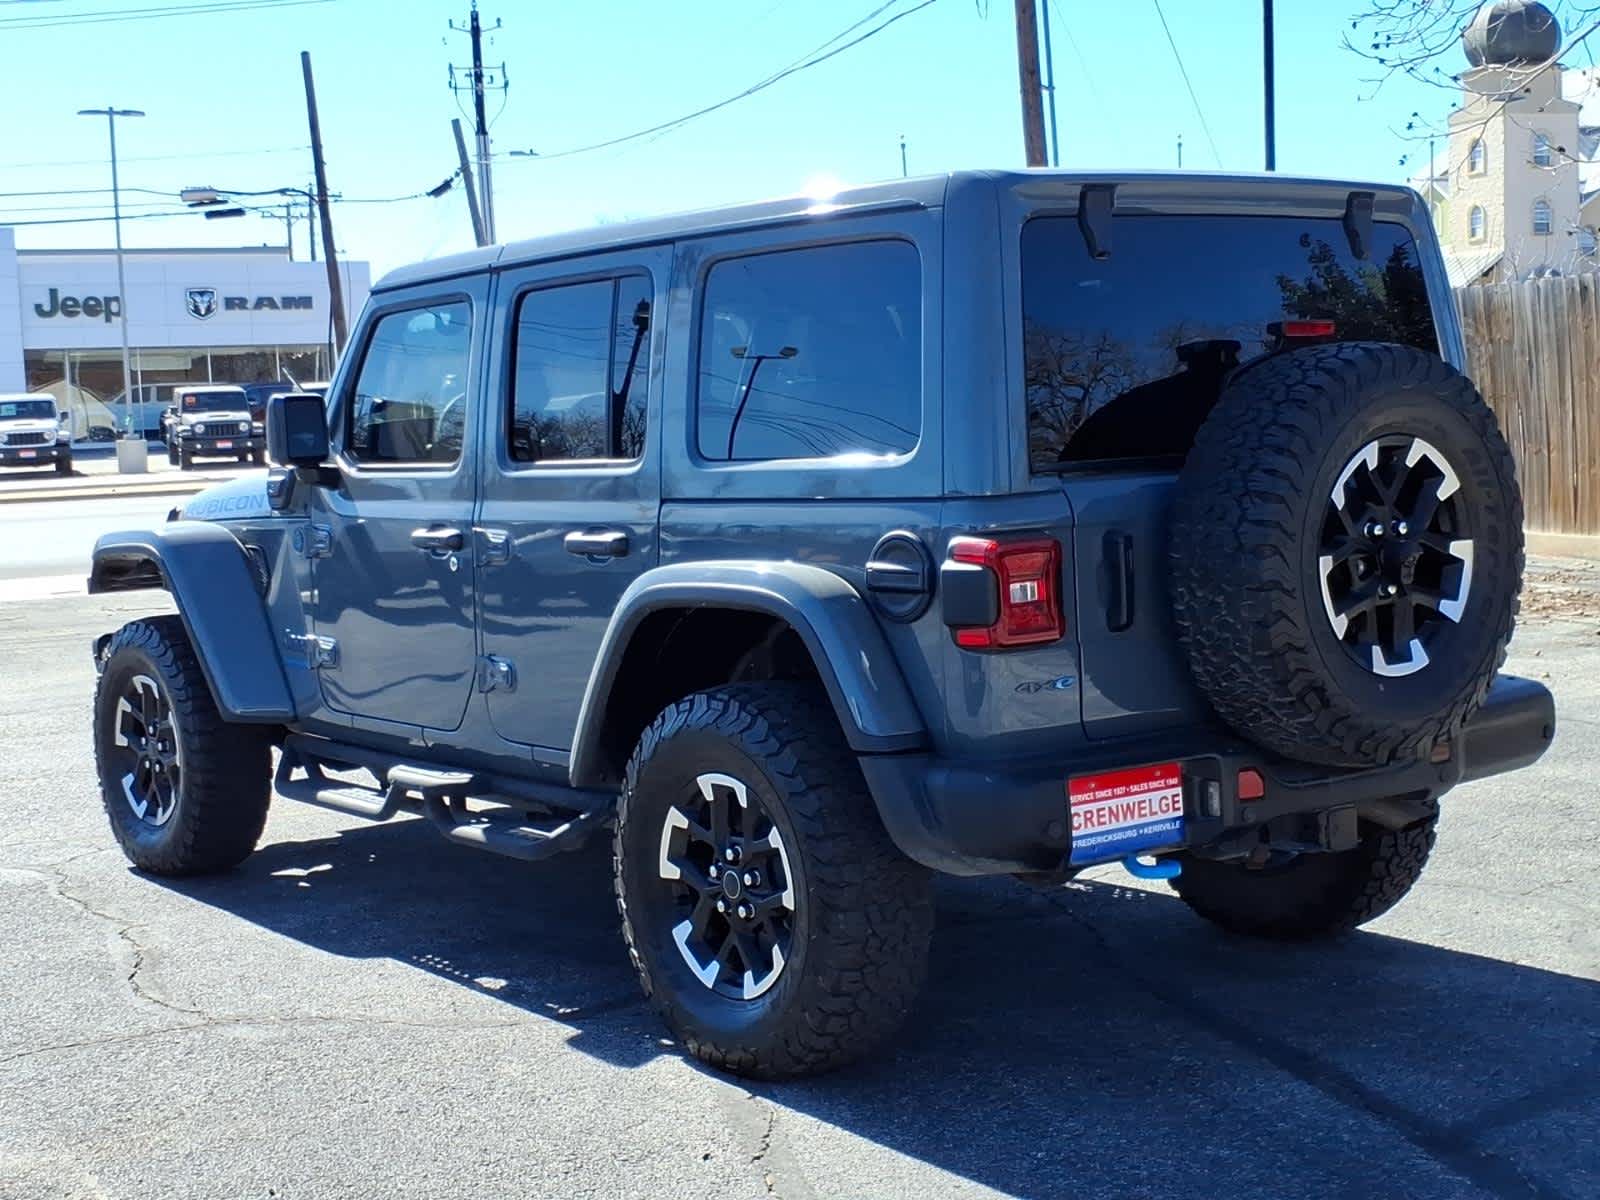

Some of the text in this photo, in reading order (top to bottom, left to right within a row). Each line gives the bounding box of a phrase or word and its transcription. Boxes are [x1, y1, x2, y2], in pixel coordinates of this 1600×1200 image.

[35, 288, 121, 323] Jeep
[224, 296, 313, 310] RAM
[1070, 792, 1095, 803] SERVICE
[1096, 788, 1112, 799] SINCE
[1130, 782, 1148, 792] SALES
[1149, 779, 1166, 789] SINCE
[1071, 793, 1181, 831] CRENWELGE
[1072, 820, 1181, 849] FREDERICKSBURG KERRVILLE
